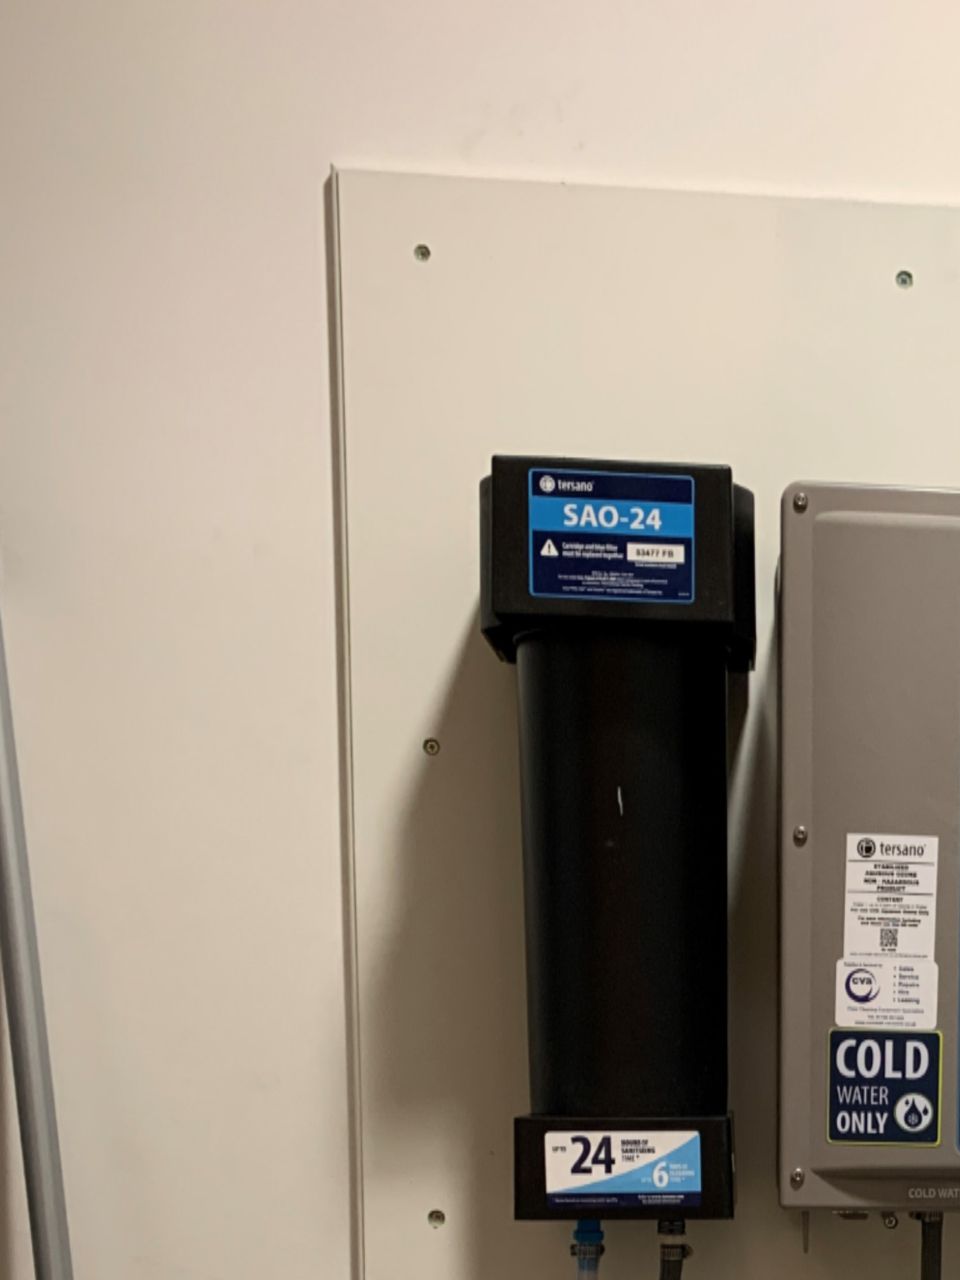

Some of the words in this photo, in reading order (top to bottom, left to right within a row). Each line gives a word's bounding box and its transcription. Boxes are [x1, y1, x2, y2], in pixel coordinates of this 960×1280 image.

[563, 503, 662, 531] SAO-24
[879, 841, 925, 857] tersano
[836, 1038, 930, 1079] COLD
[837, 1085, 889, 1105] WATER
[836, 1111, 888, 1134] ONLY
[570, 1135, 616, 1174] 24
[652, 1161, 669, 1188] 6
[908, 1188, 936, 1198] COLD
